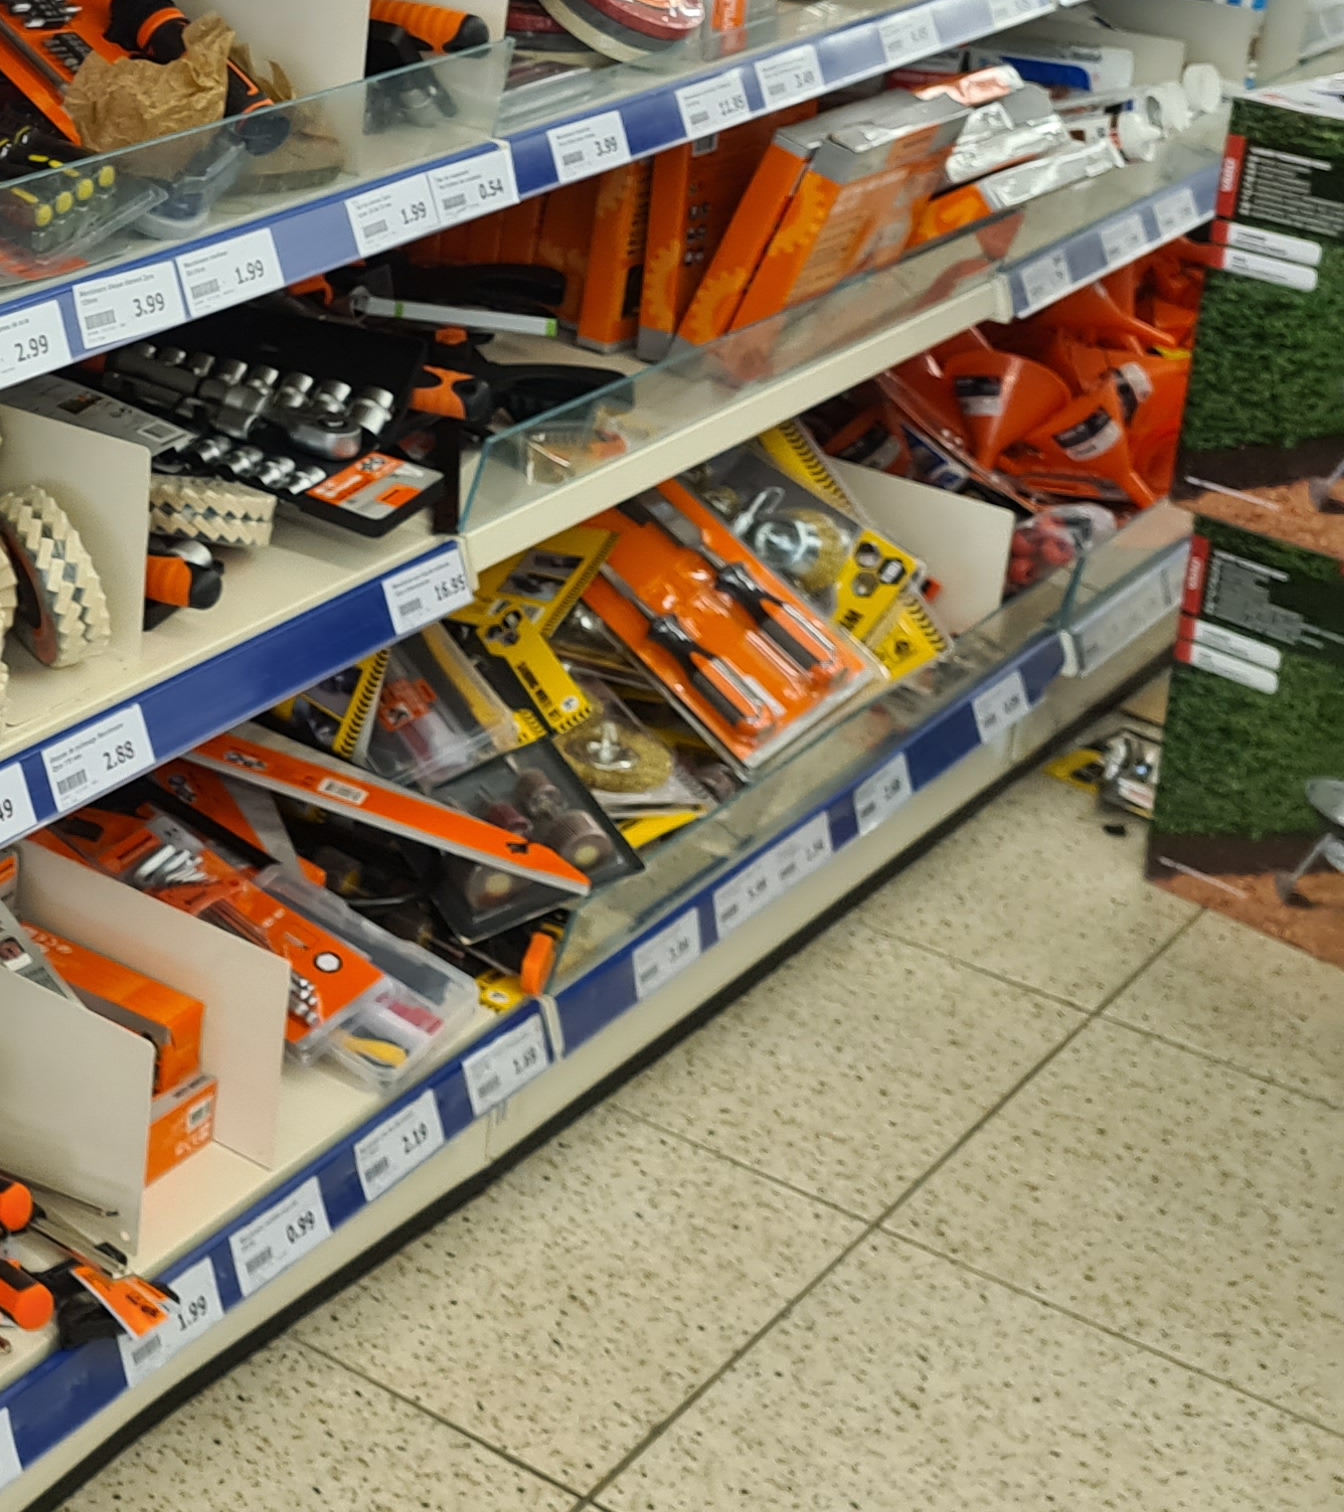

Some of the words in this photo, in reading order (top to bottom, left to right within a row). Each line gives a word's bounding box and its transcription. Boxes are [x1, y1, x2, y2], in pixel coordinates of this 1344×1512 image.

[235, 260, 265, 284] 1.99
[133, 292, 166, 318] 3.99
[14, 334, 49, 363] 2.99
[102, 740, 135, 771] 2.88
